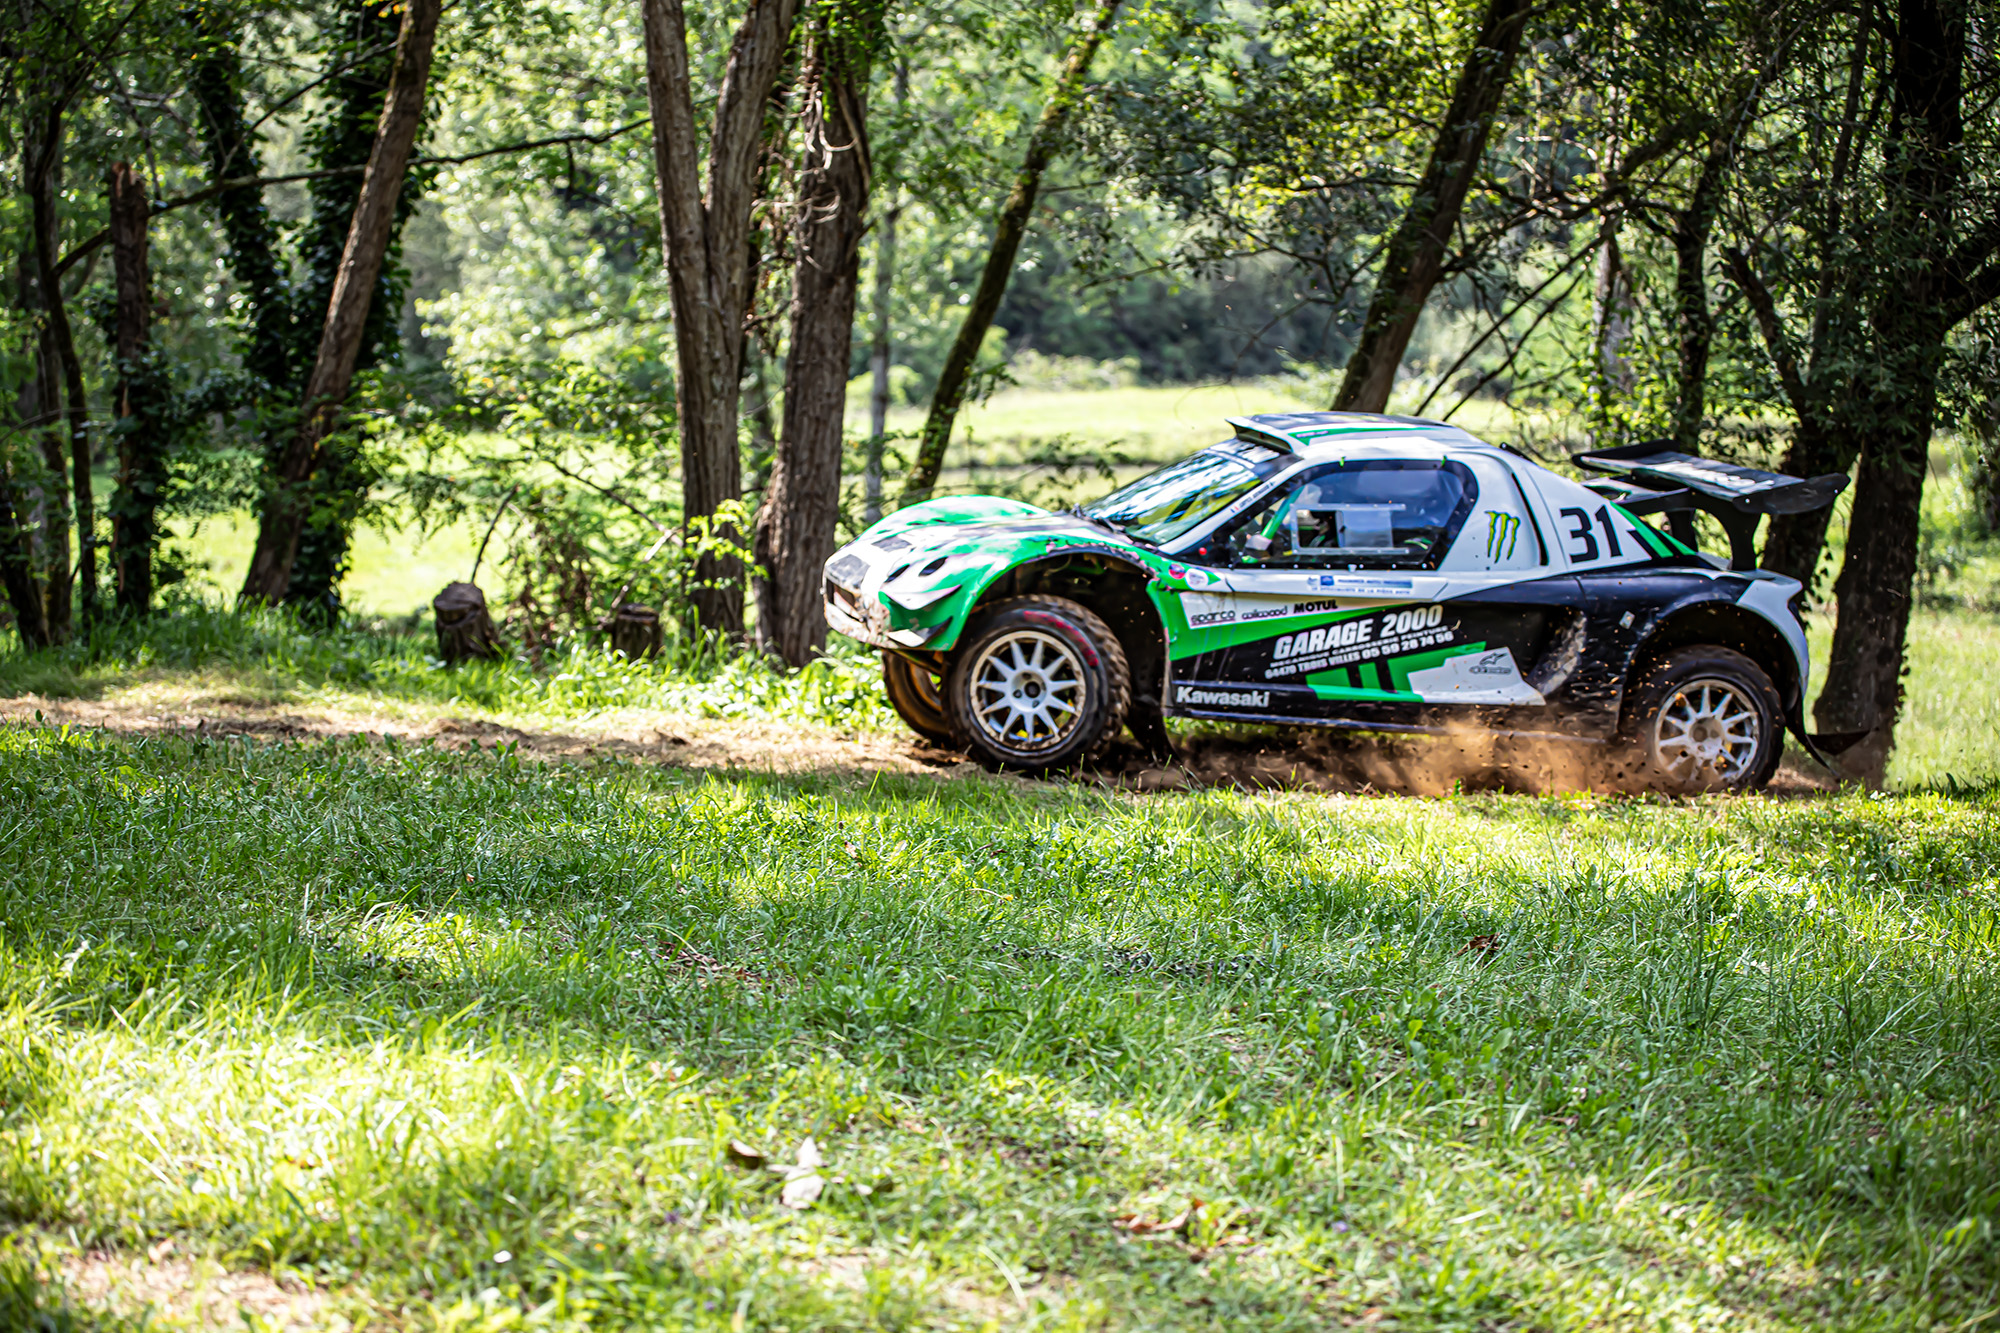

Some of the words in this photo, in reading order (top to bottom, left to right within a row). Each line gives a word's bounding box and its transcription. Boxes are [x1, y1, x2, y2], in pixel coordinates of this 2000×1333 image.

[1559, 504, 1623, 564] 31
[1191, 610, 1236, 625] sparco
[1293, 599, 1338, 614] MOTUL
[1272, 618, 1374, 660] GARAGE
[1380, 604, 1444, 638] 2000
[1297, 658, 1329, 673] TROIS
[1328, 651, 1361, 667] VILLES
[1176, 685, 1270, 708] Kawasaki
